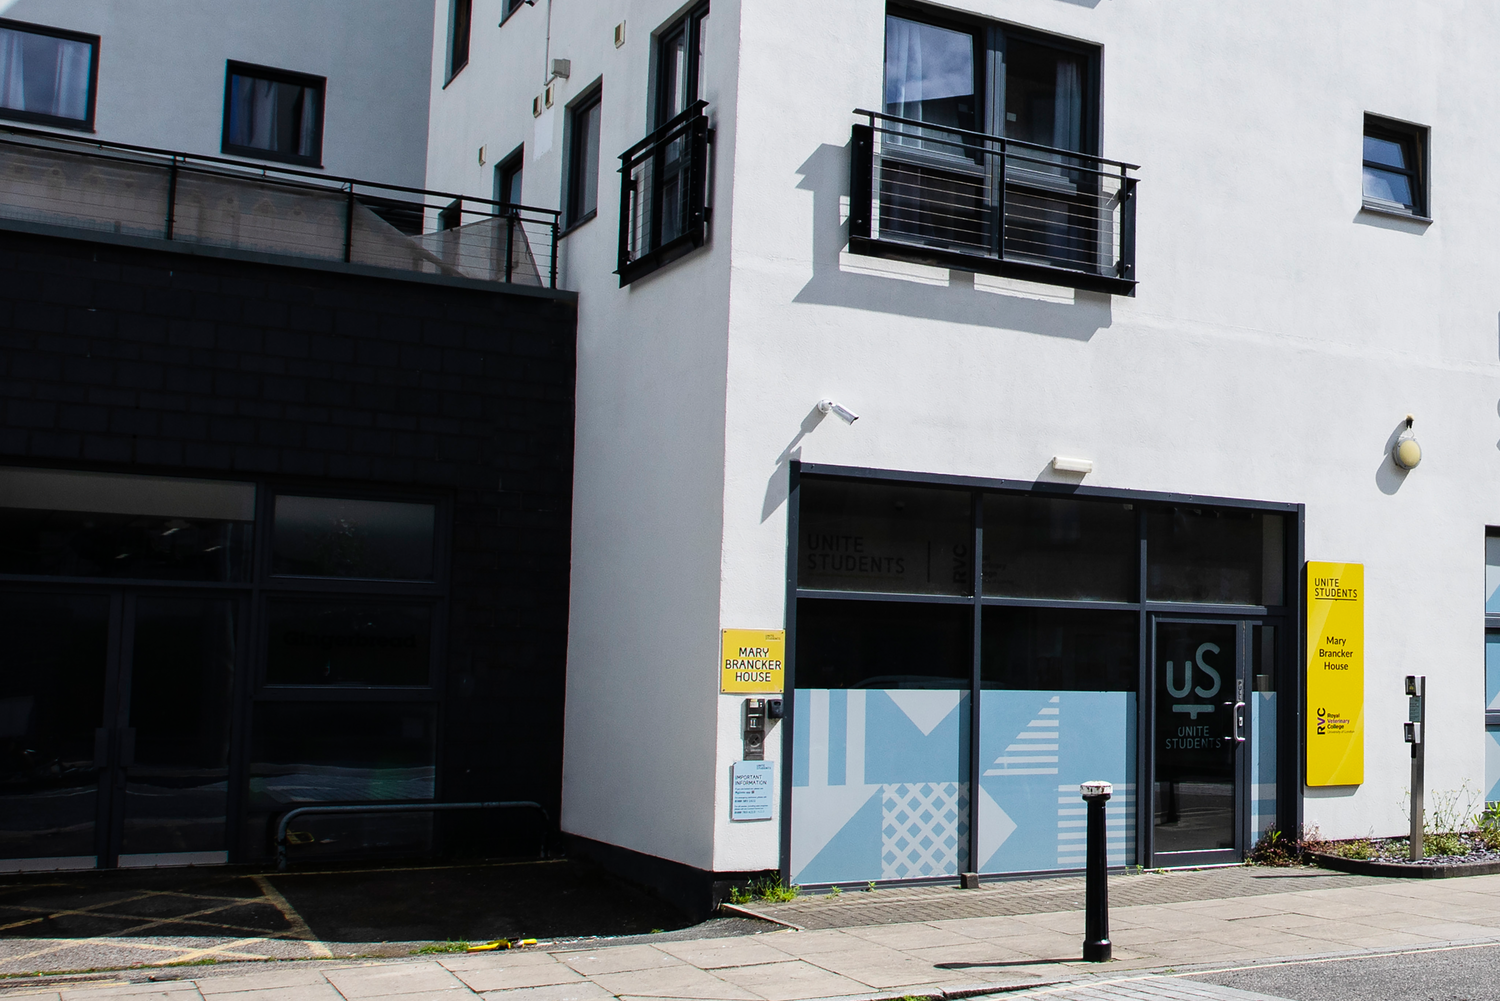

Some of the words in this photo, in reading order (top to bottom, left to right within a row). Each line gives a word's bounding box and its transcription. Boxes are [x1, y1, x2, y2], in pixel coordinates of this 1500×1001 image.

[807, 533, 864, 553] UNITE
[807, 553, 905, 574] STUDENTS
[952, 543, 968, 584] RVC
[1314, 578, 1339, 587] UNITE
[1314, 588, 1358, 598] STUDENTS
[283, 630, 417, 650] Gingerbread
[1326, 636, 1346, 646] Mary
[738, 647, 769, 658] MARY
[1319, 648, 1354, 658] Brancker
[725, 659, 782, 670] BRANCKER
[1324, 661, 1349, 671] House
[735, 671, 771, 682] HOUSE
[1317, 707, 1326, 735] RVC
[1177, 725, 1210, 737] UNITE
[1165, 737, 1221, 749] STUDENTS
